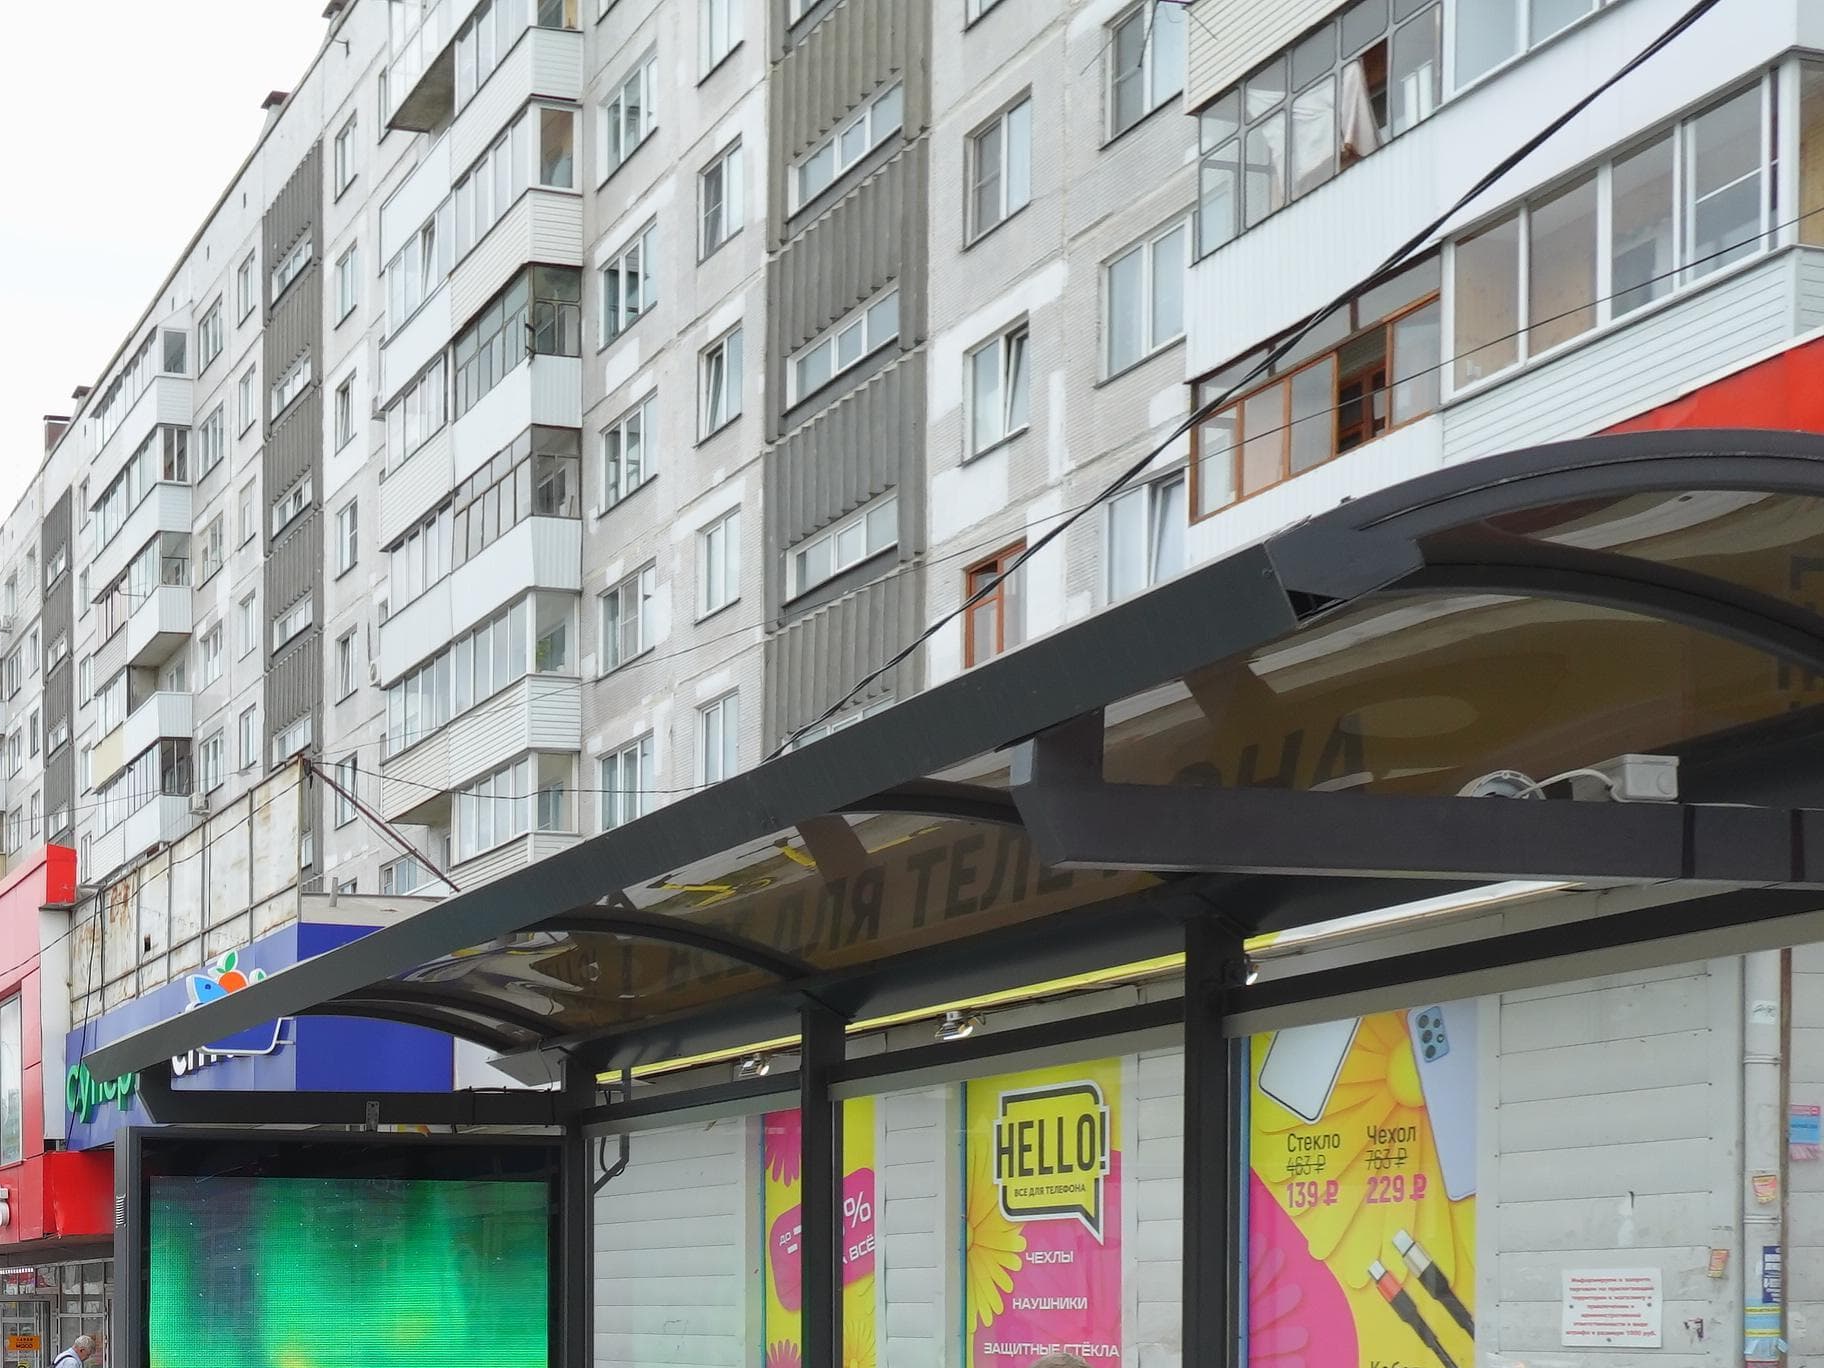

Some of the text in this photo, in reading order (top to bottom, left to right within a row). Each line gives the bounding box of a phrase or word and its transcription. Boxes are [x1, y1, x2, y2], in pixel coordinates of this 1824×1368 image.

[1287, 1133, 1341, 1153] Стекло
[1366, 1125, 1417, 1145] Чехол
[996, 1112, 1106, 1179] HELLO!
[1014, 1184, 1087, 1197] ВСЕ ДЛЯ ТЕЛЕФОНА
[1287, 1180, 1318, 1208] 139
[1365, 1174, 1404, 1204] 229
[1025, 1251, 1073, 1264] ЧЕХЛЫ
[1012, 1297, 1088, 1310] НАУШНИКИ
[984, 1342, 1060, 1357] ЗАЩИТНЫЕ
